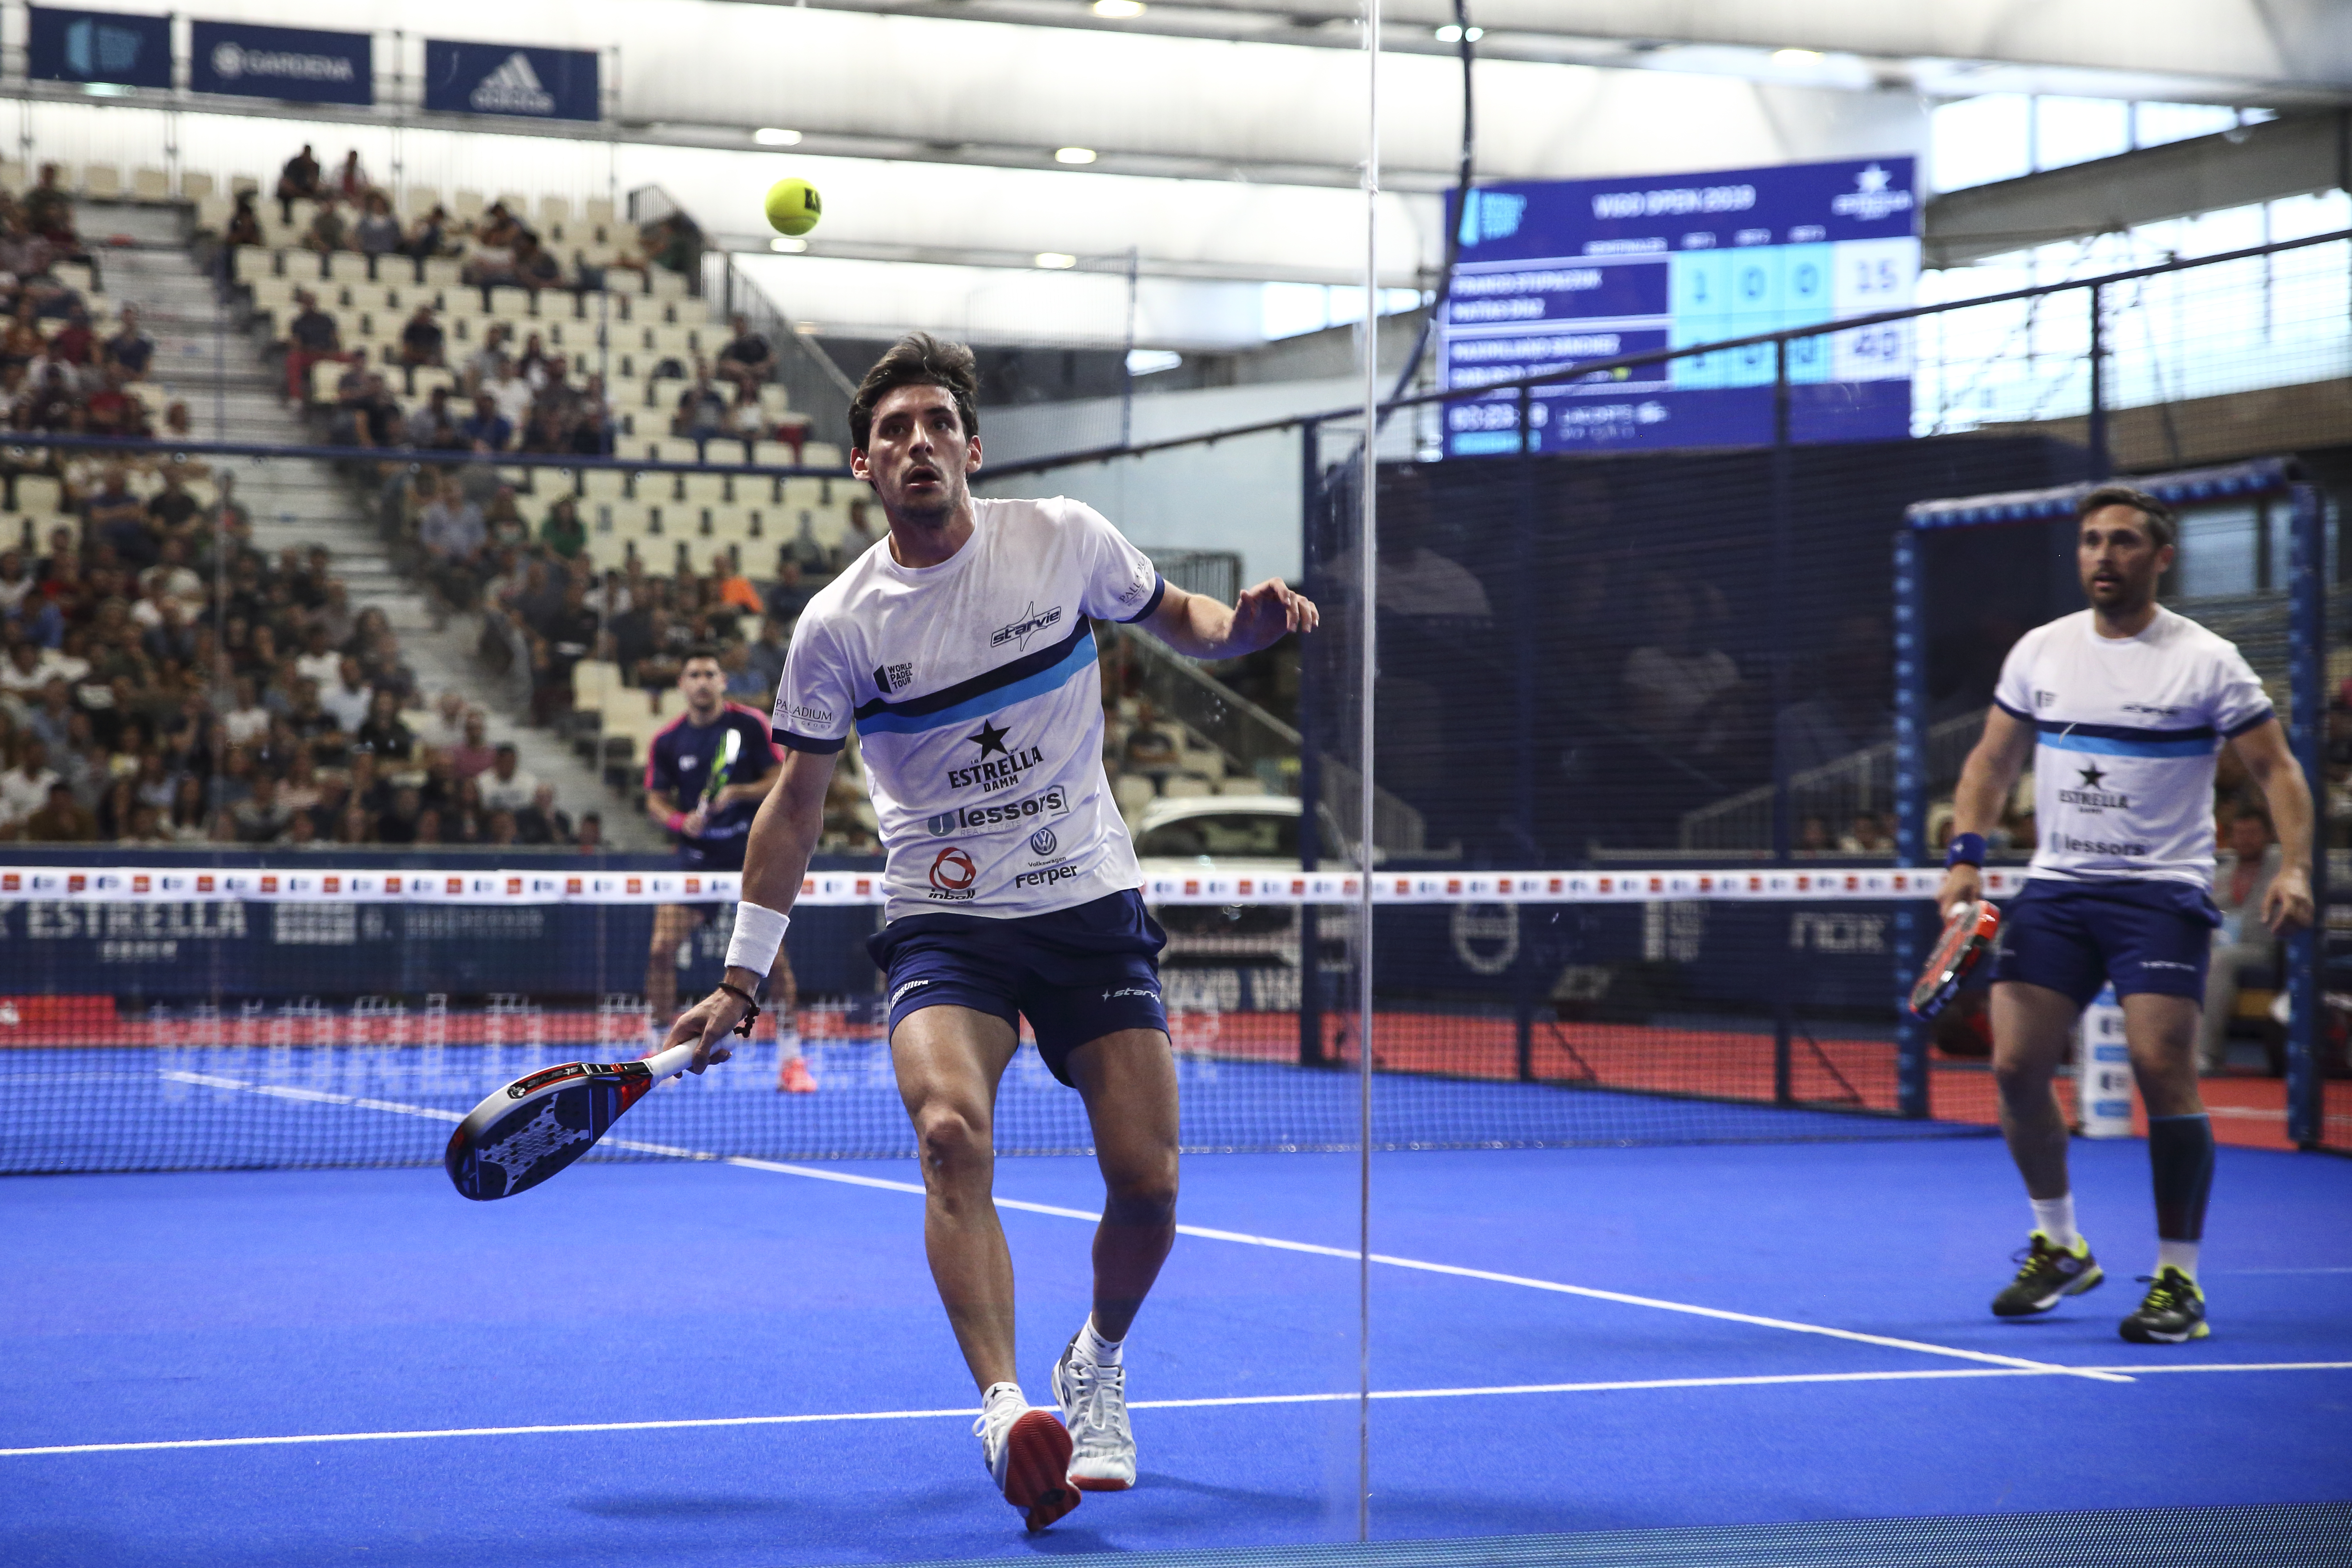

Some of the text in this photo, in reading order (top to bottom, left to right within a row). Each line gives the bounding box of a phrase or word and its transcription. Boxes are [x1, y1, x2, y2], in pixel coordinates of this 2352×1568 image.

[993, 611, 1060, 645] starvie
[887, 663, 912, 674] WORLD
[890, 670, 913, 682] PADEL
[892, 677, 911, 689] TOUR
[776, 698, 831, 721] PALADIUM
[948, 745, 1044, 789] ESTRELLA
[983, 775, 1019, 793] DAMM
[2058, 789, 2130, 808] ESTRELLA
[959, 792, 1062, 828] lessors
[961, 820, 1021, 836] REAL ESTATE
[1028, 856, 1066, 867] Volkswagen
[1016, 865, 1077, 889] Ferper
[928, 888, 975, 900] inball
